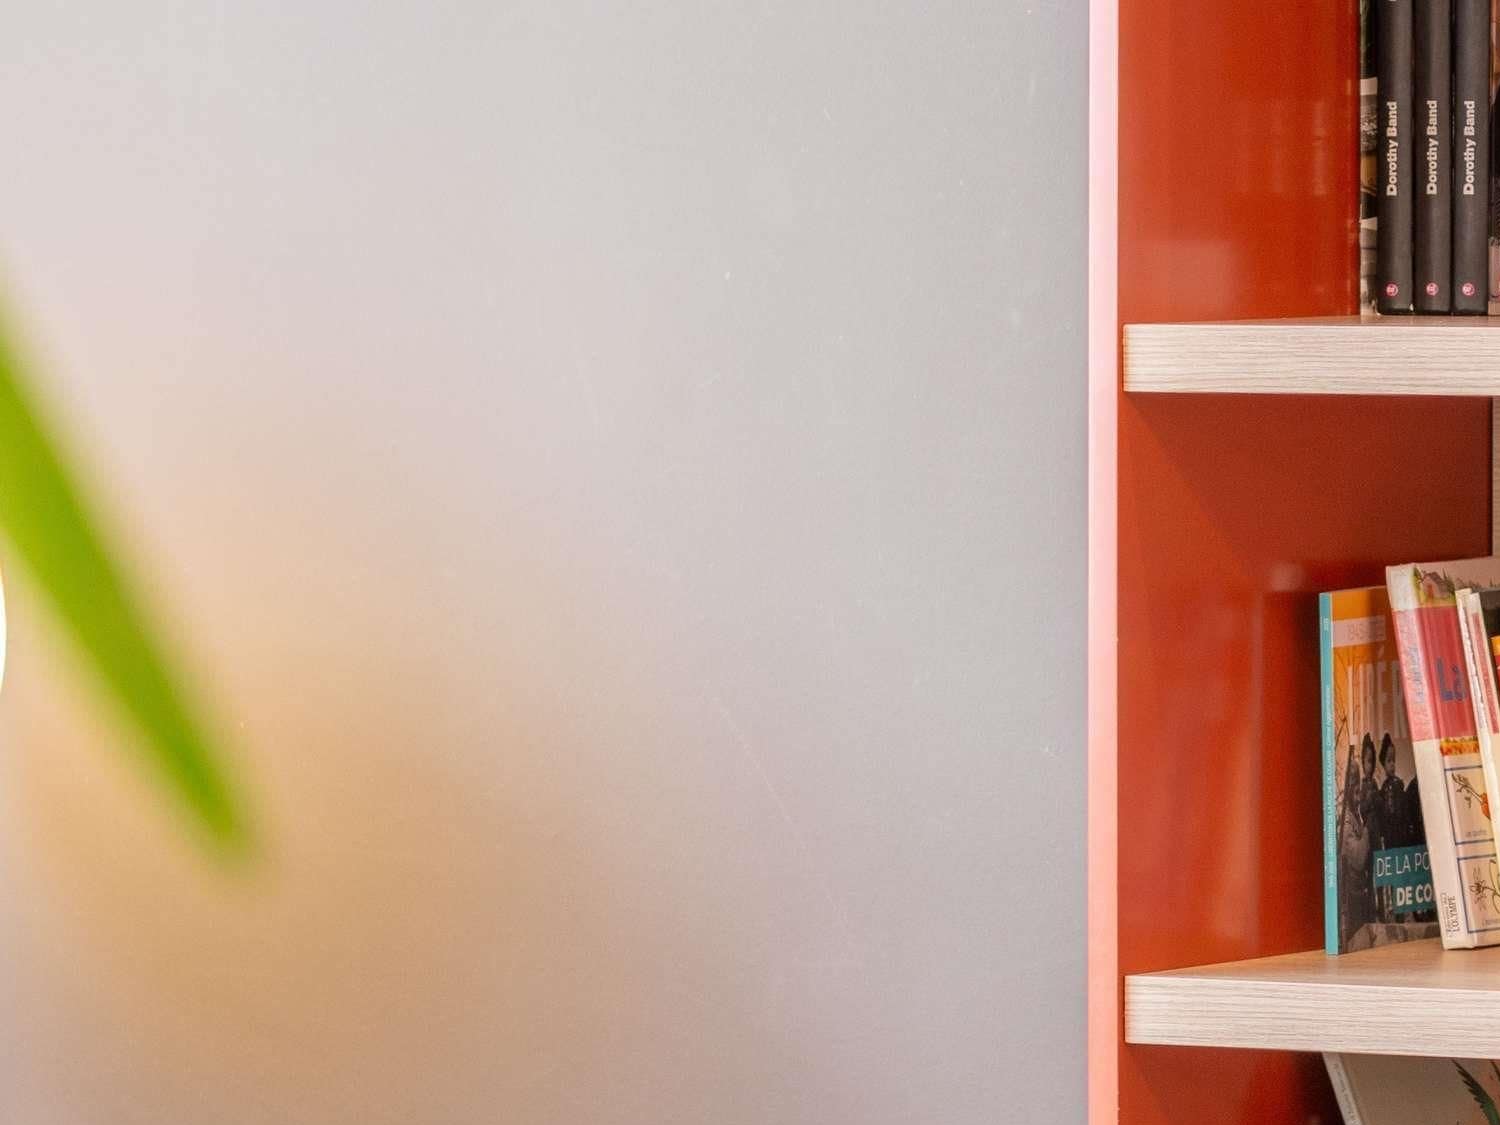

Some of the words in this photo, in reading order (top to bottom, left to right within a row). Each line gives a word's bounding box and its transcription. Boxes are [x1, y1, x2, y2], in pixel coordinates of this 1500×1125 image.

[1386, 101, 1398, 137] Band
[1426, 100, 1438, 136] Band
[1463, 100, 1475, 136] Band
[1386, 139, 1399, 197] Dorothy
[1426, 138, 1439, 195] Dorothy
[1463, 138, 1476, 196] Dorothy
[1376, 857, 1393, 878] DE
[1395, 854, 1412, 875] LA
[1395, 886, 1414, 907] DE
